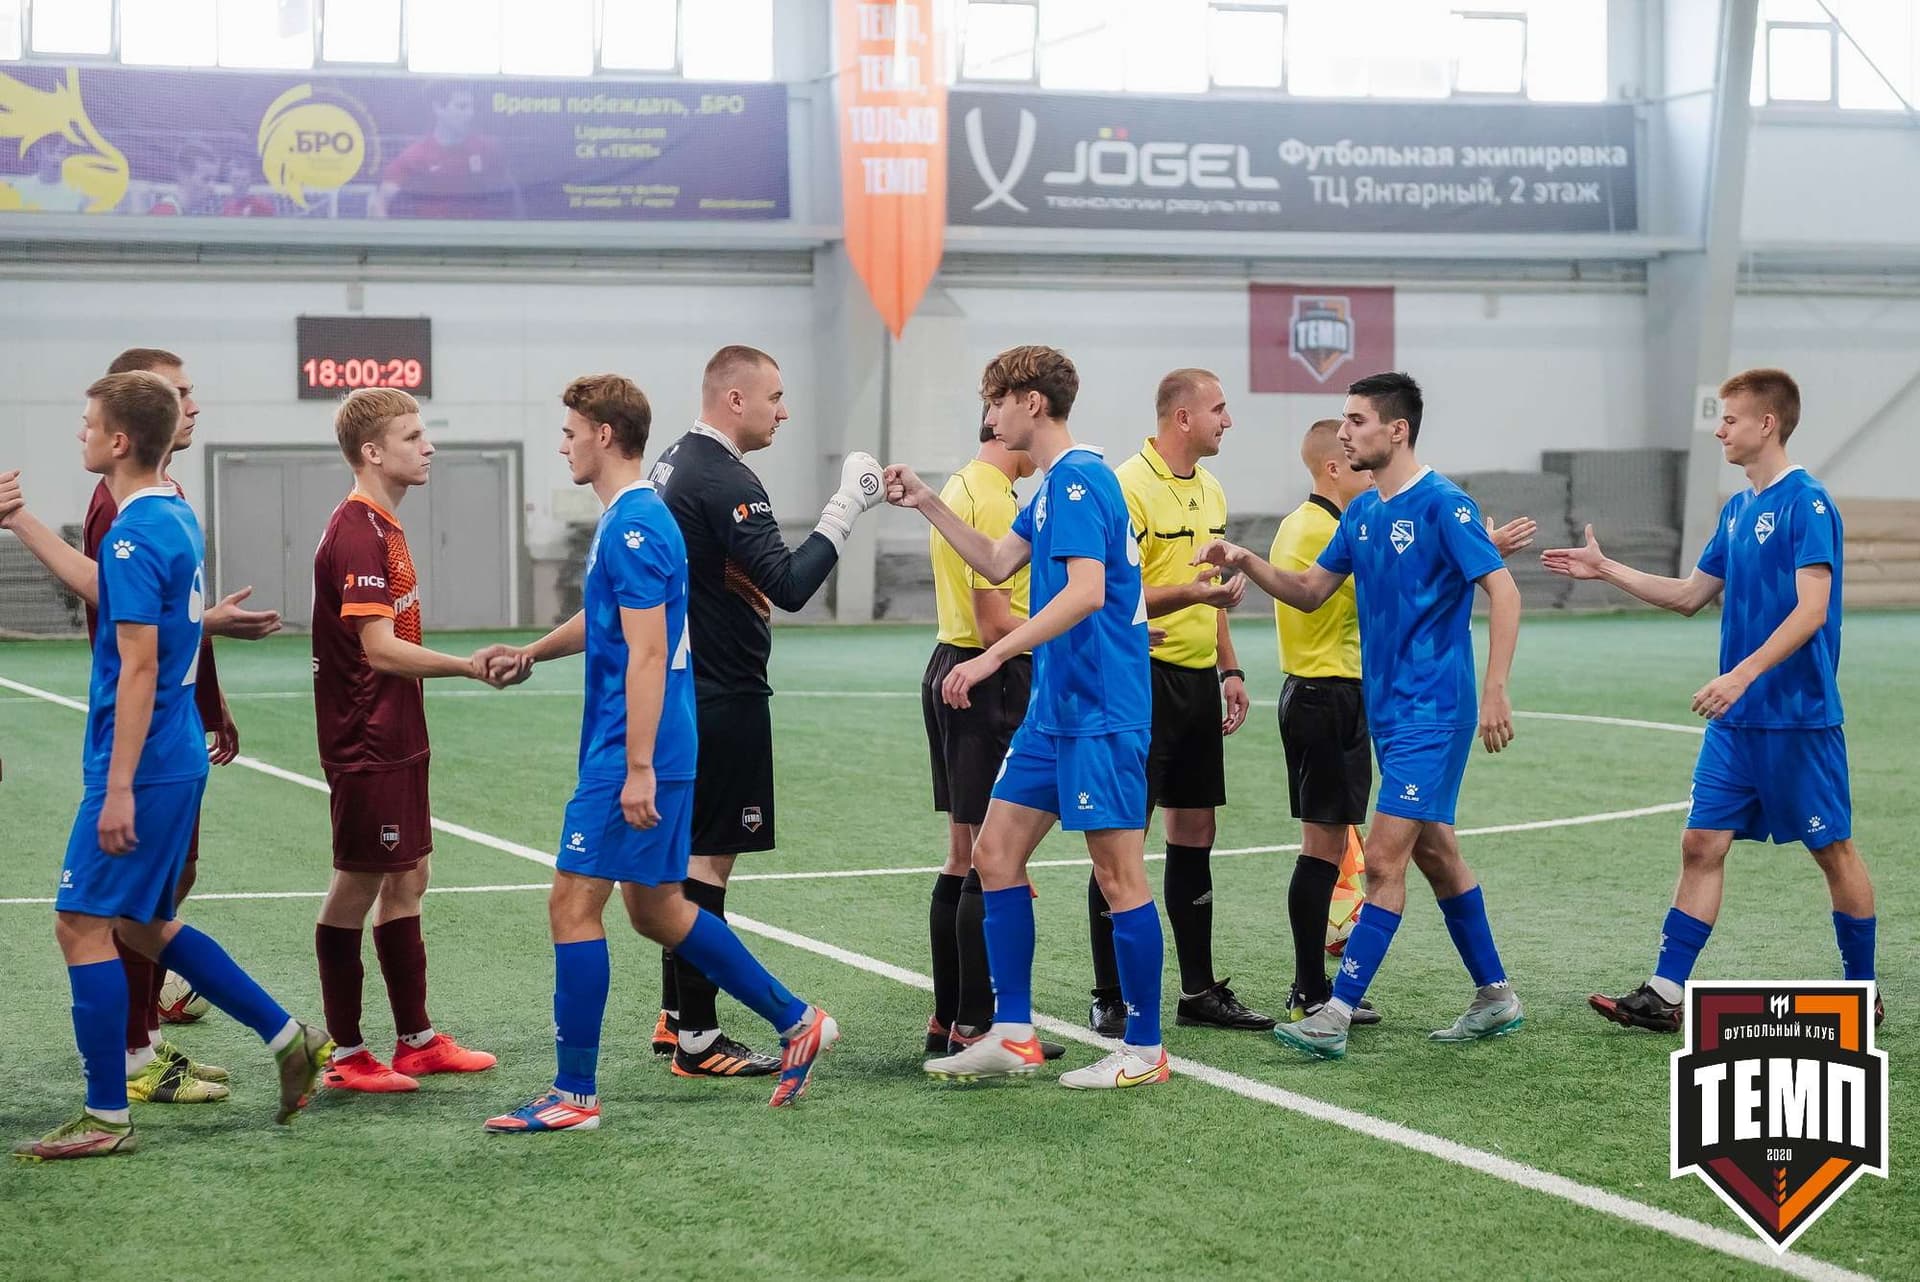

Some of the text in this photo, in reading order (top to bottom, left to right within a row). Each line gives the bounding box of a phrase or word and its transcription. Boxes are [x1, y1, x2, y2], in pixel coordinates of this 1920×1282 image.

[848, 106, 939, 144] ТОЛЬКО
[289, 130, 354, 154] .БРО
[1278, 139, 1627, 172] Футбольная экипировка
[861, 157, 928, 195] ТЕМП!
[1308, 175, 1600, 209] ТЦ Янтарный, 2 этаж
[1296, 320, 1347, 351] ТЕМП
[303, 358, 422, 388] 18:00:29
[357, 576, 385, 589] ПСБ
